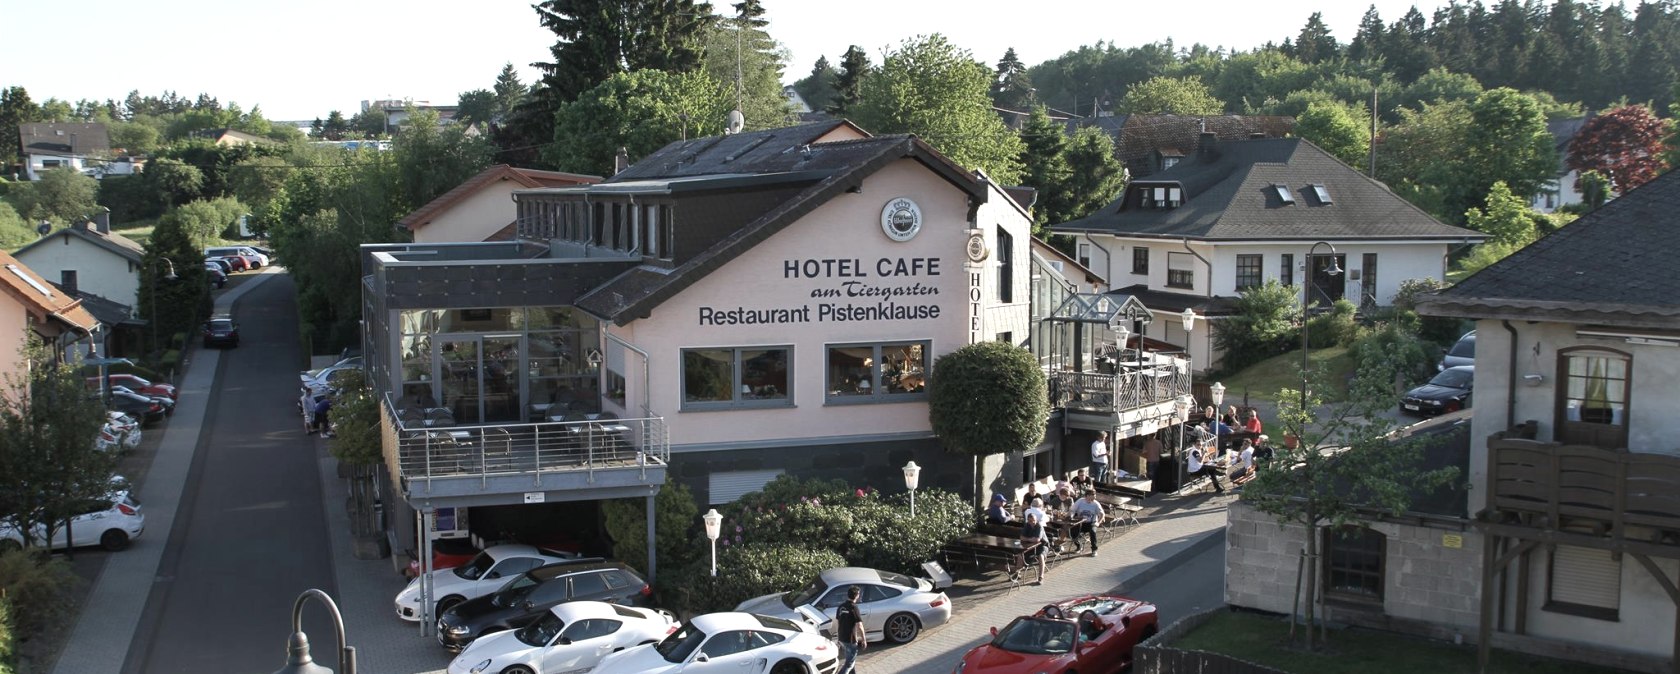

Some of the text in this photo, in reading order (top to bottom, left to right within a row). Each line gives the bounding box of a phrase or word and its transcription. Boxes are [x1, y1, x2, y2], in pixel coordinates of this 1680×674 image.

[784, 257, 941, 278] HOTEL CAFE
[810, 280, 939, 301] am Tiergarten
[699, 302, 941, 325] Restaurant Pistenklause
